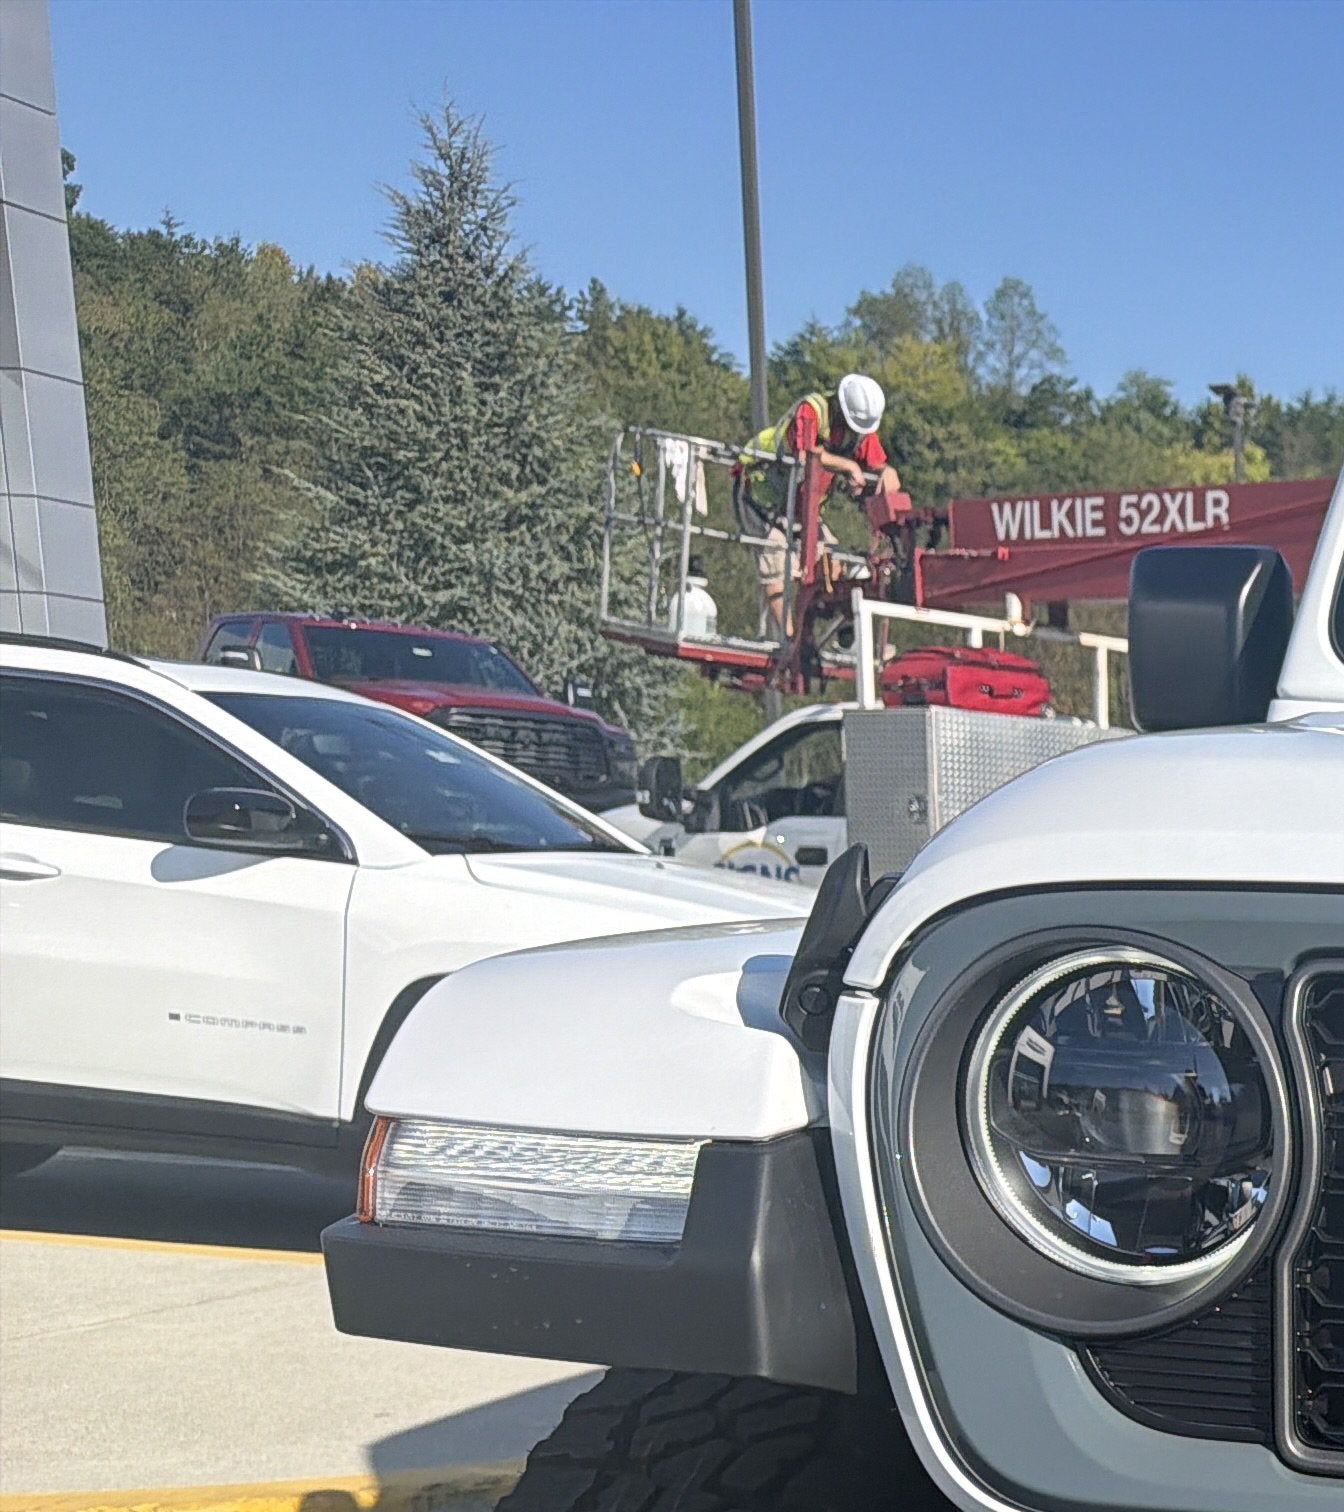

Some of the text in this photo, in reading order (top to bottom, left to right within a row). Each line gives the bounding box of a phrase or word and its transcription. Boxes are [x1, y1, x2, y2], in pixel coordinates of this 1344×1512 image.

[990, 489, 1231, 542] WILKIE 52XLR
[184, 1013, 307, 1035] COMPASS
